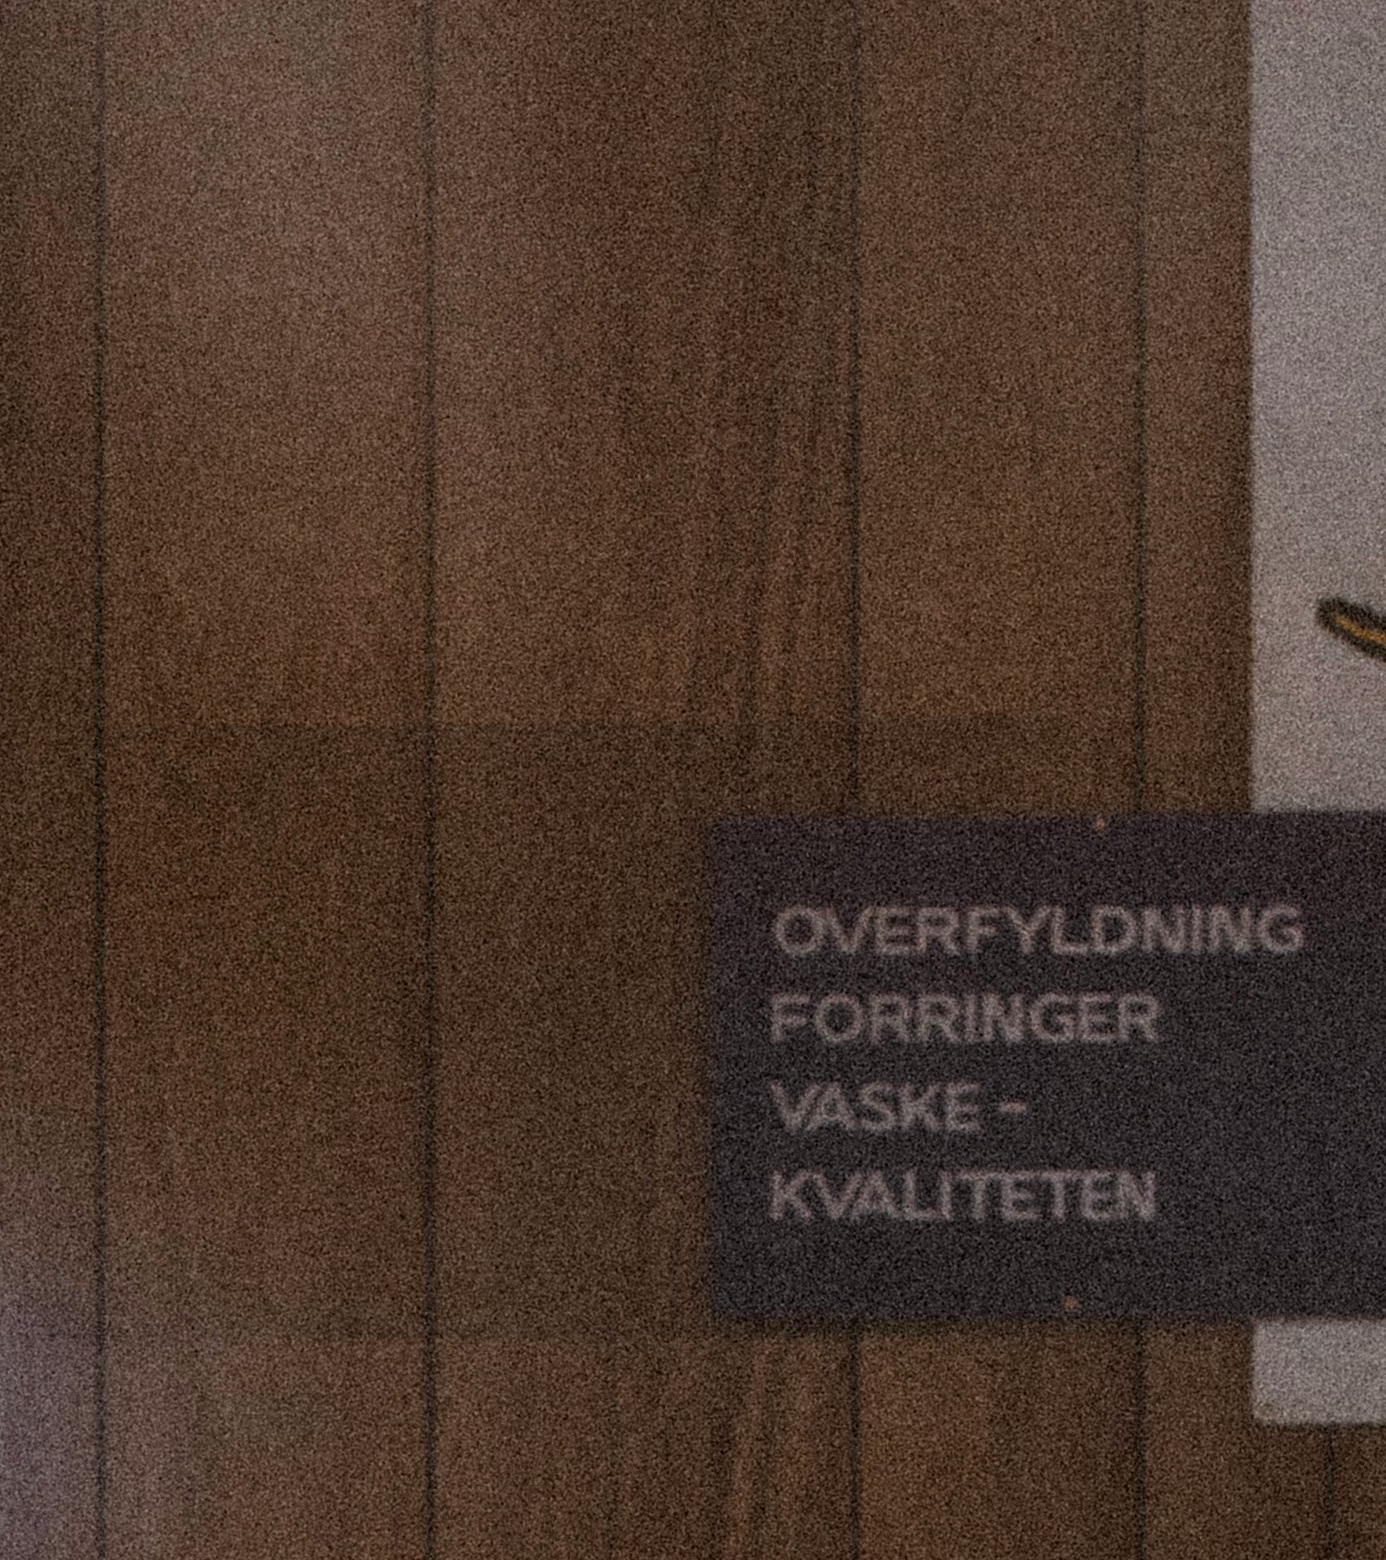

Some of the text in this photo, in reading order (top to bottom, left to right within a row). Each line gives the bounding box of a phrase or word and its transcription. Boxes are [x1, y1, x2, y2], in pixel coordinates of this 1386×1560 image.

[773, 905, 1306, 957] OVERFYLDNING
[770, 992, 1161, 1044] FORRINGER
[770, 1170, 1157, 1221] KVALITETEN
